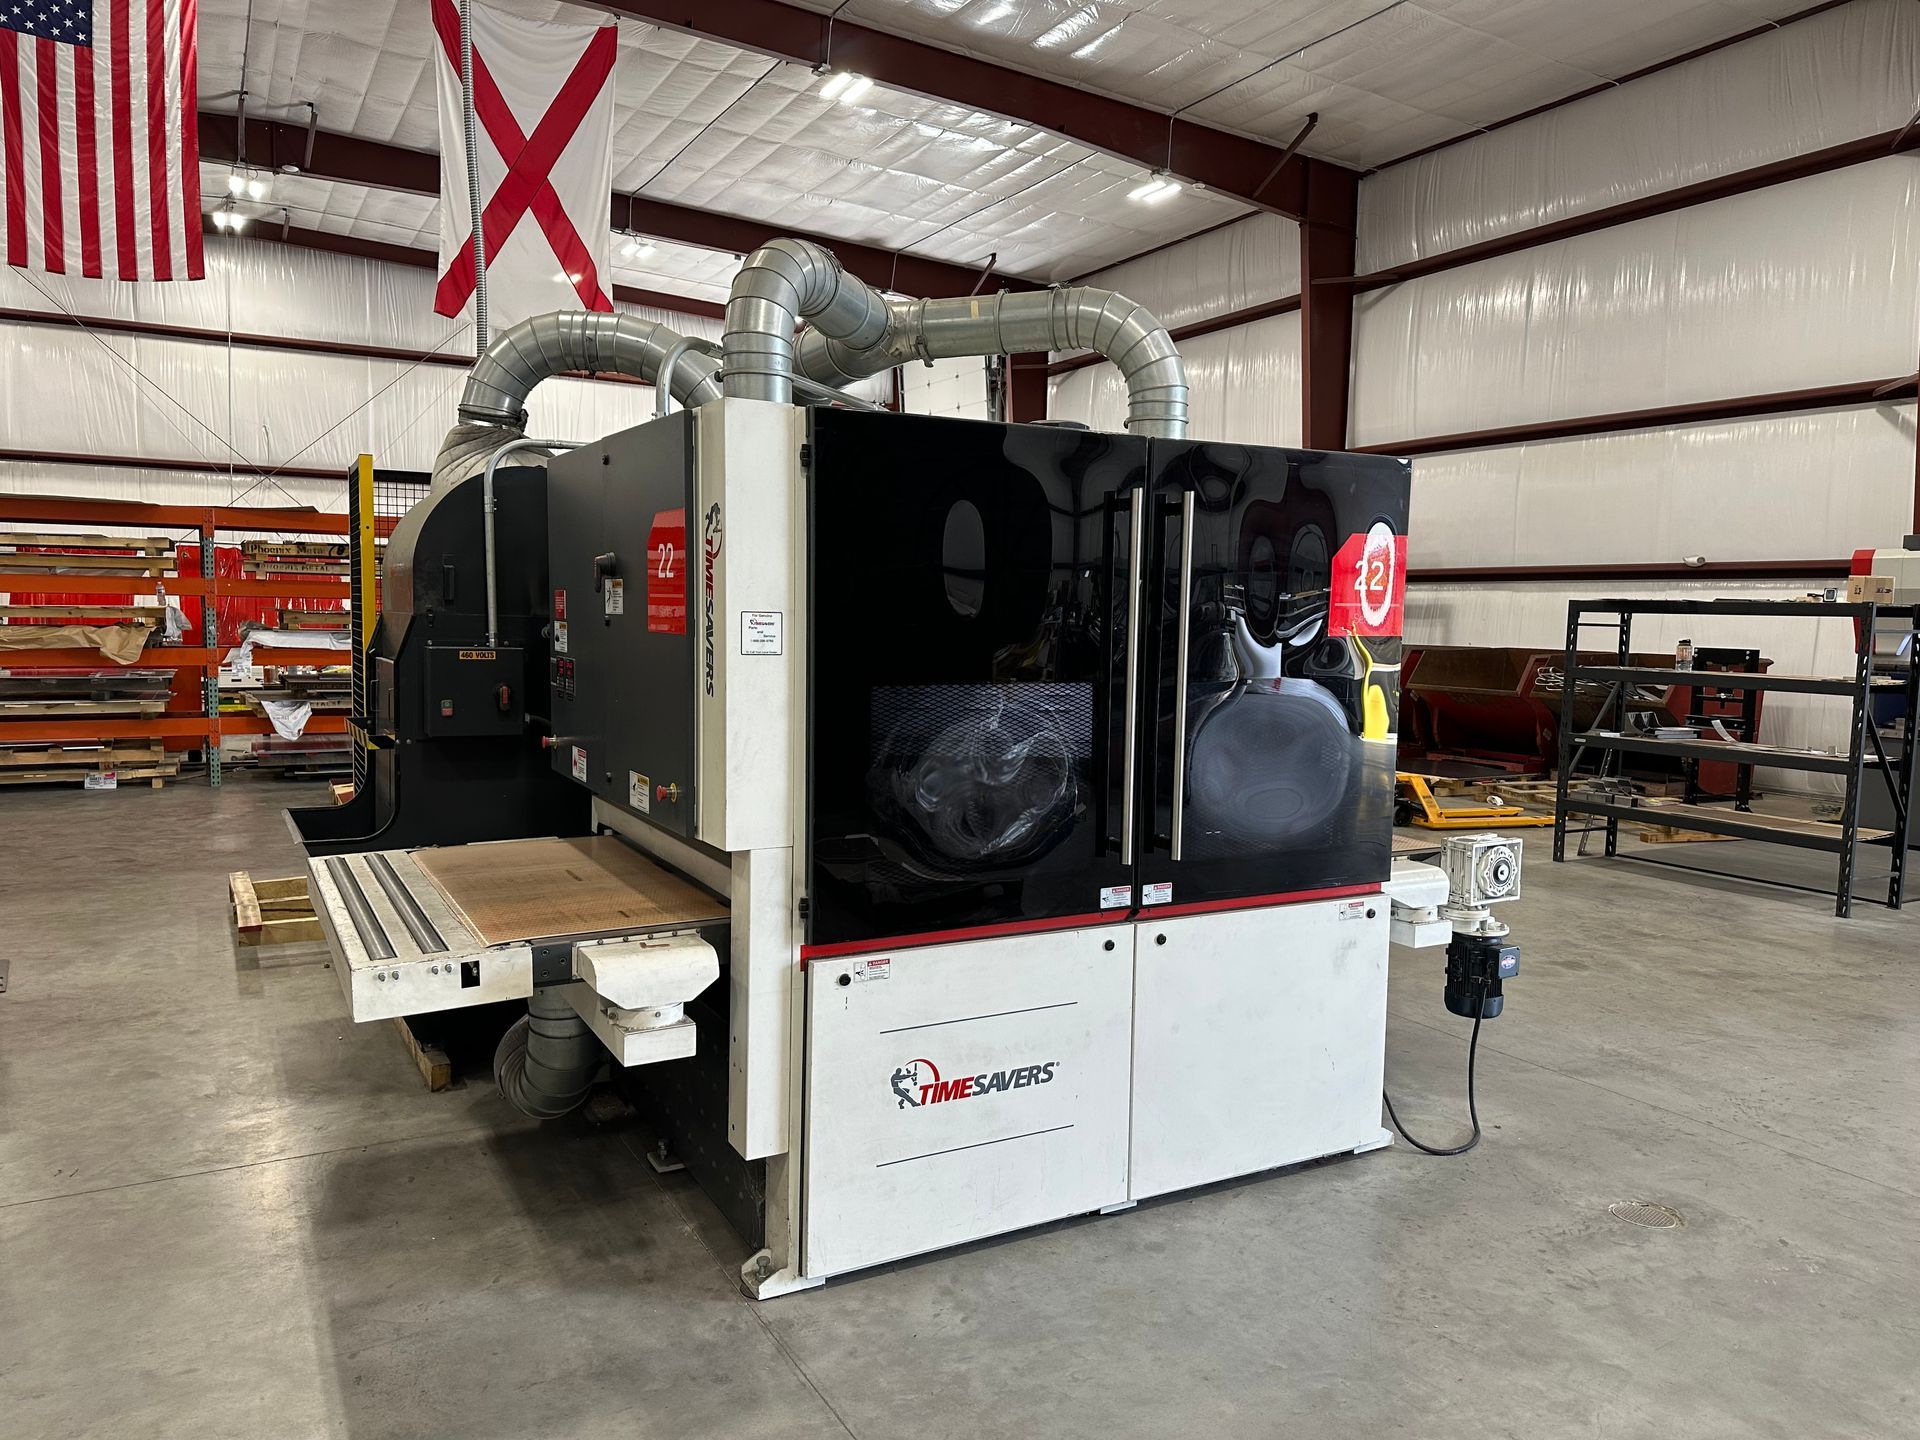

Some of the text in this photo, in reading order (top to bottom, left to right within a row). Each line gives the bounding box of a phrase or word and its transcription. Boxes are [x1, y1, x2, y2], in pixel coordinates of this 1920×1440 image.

[250, 544, 291, 554] Phoenix
[658, 543, 674, 578] 22
[705, 535, 714, 697] TIMESAVERS
[919, 1061, 1055, 1106] TIMESAVERS
